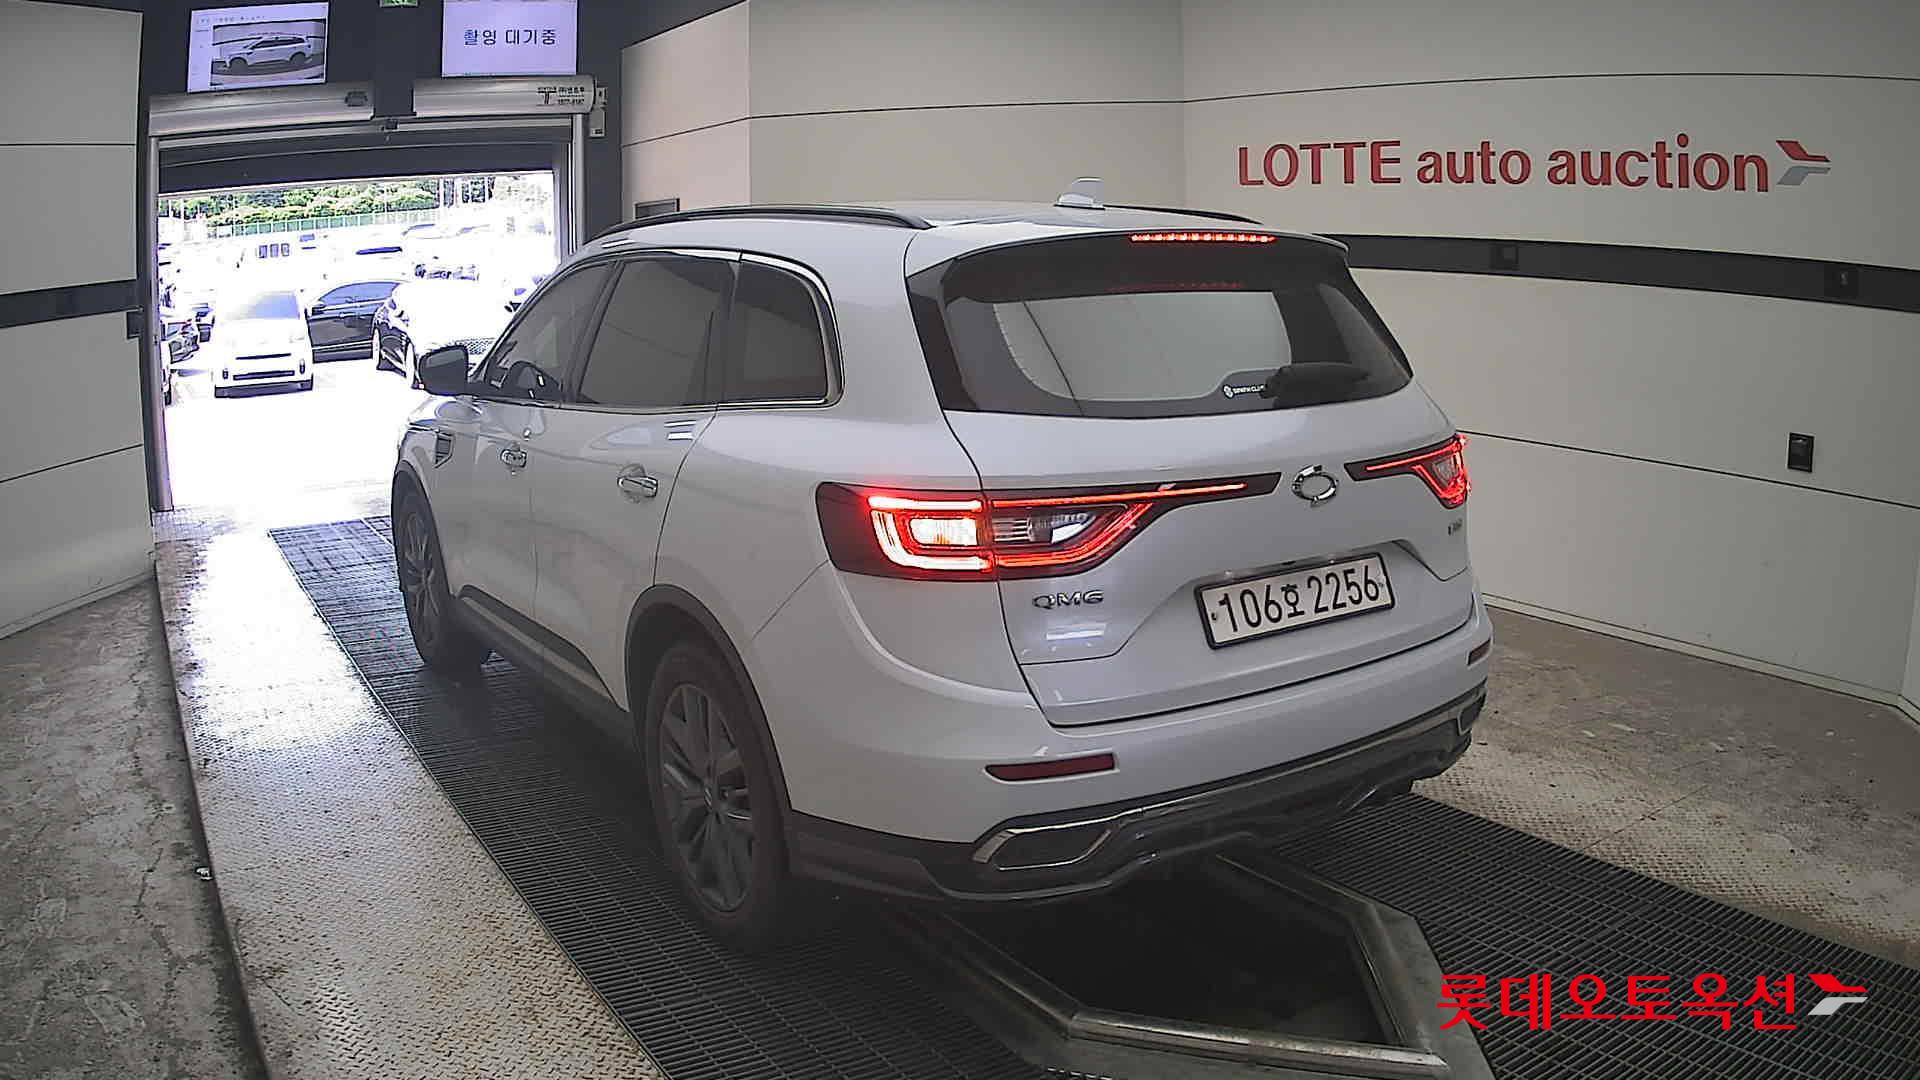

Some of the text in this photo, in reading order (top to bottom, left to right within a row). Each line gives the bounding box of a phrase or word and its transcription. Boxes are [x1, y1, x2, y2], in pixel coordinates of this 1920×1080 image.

[505, 28, 556, 47] 대기중
[1240, 133, 1769, 193] LOTTE auto auction
[1032, 589, 1105, 610] QM6
[1217, 564, 1380, 633] 106호 2256
